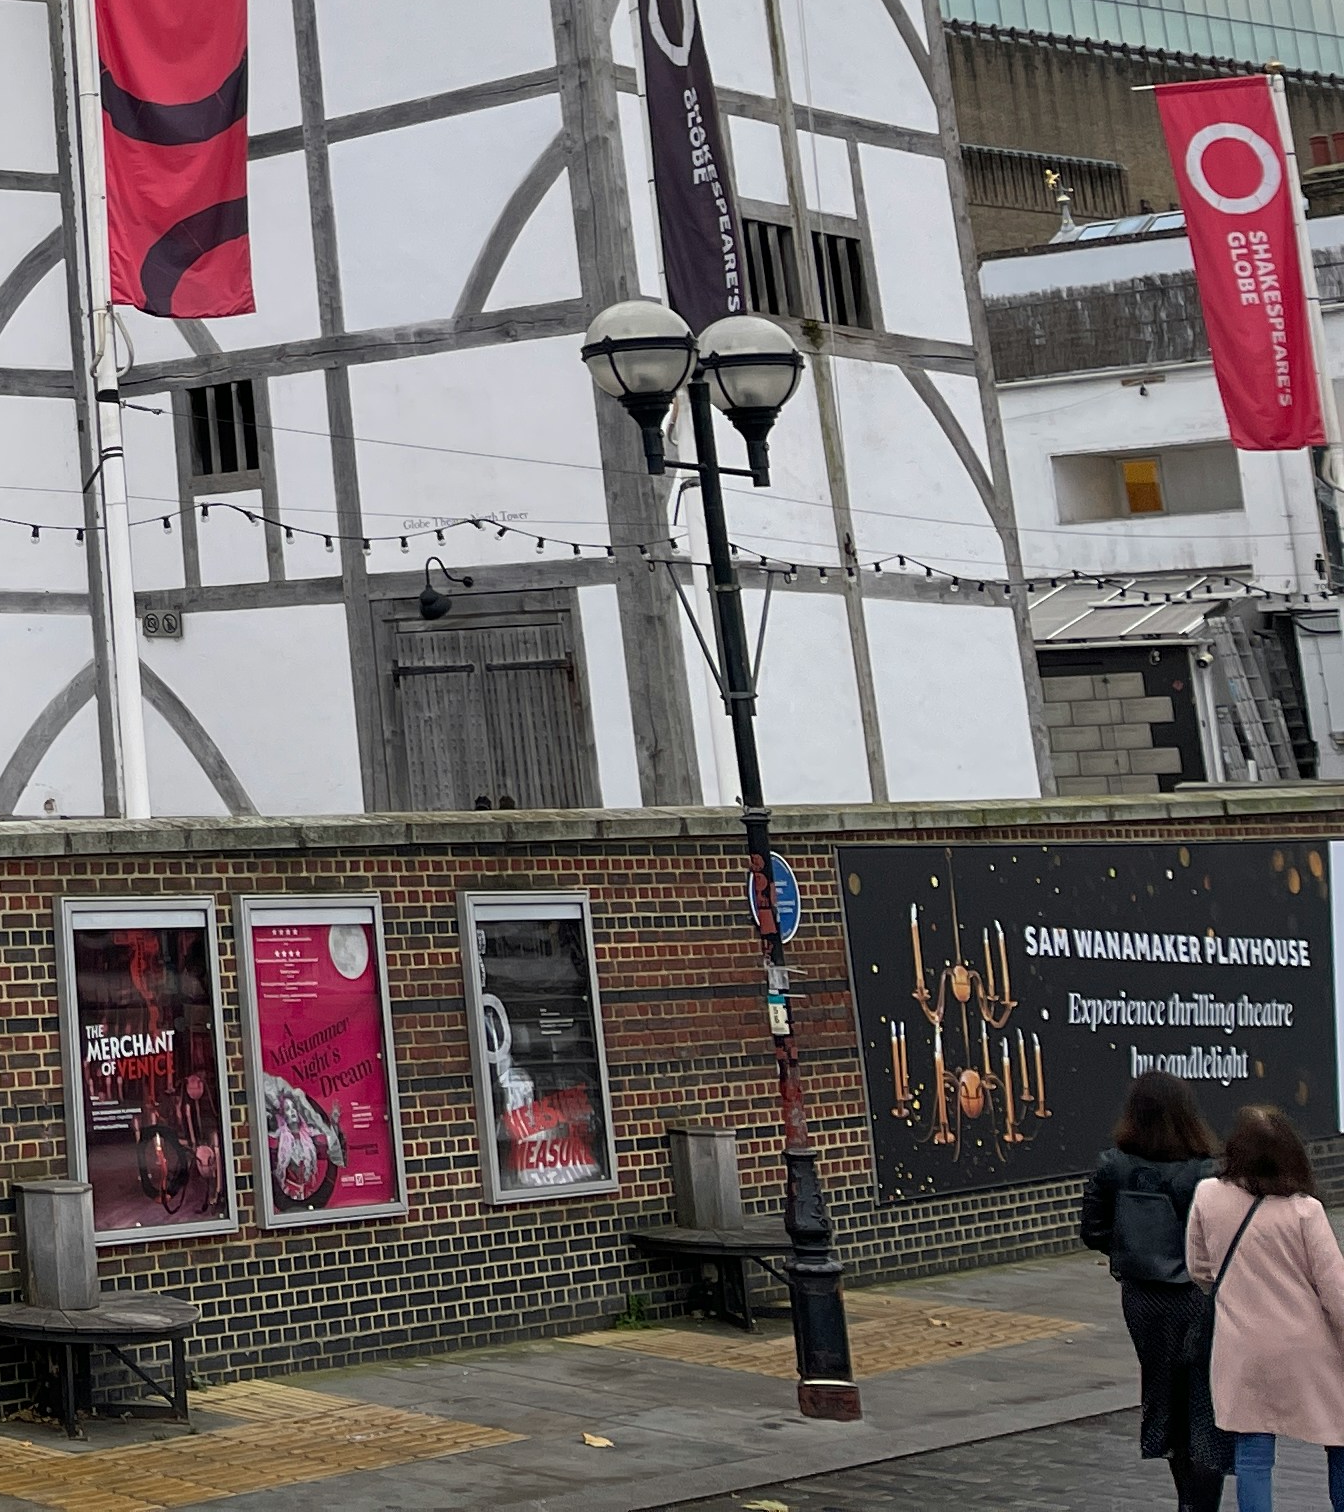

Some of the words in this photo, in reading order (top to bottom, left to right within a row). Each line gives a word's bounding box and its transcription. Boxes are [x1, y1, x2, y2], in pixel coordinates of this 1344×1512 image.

[1227, 230, 1260, 306] GLOBE
[1249, 230, 1293, 407] SHAKESPEARE'S
[403, 519, 430, 530] Globe
[1025, 925, 1071, 957] SAM
[1072, 928, 1202, 964] WANAMAKER
[1206, 936, 1311, 968] PLAYHOUSE
[85, 1024, 105, 1039] THE
[283, 1021, 293, 1037] A
[1068, 990, 1165, 1032] Experience
[1167, 992, 1236, 1035] thrilling
[1237, 994, 1294, 1027] theatre
[86, 1029, 175, 1063] MERCHANT
[269, 1016, 349, 1066] Midsummer
[101, 1061, 116, 1076] OF
[117, 1052, 175, 1081] VENICE
[291, 1044, 342, 1083] Night's
[319, 1058, 373, 1098] Dream
